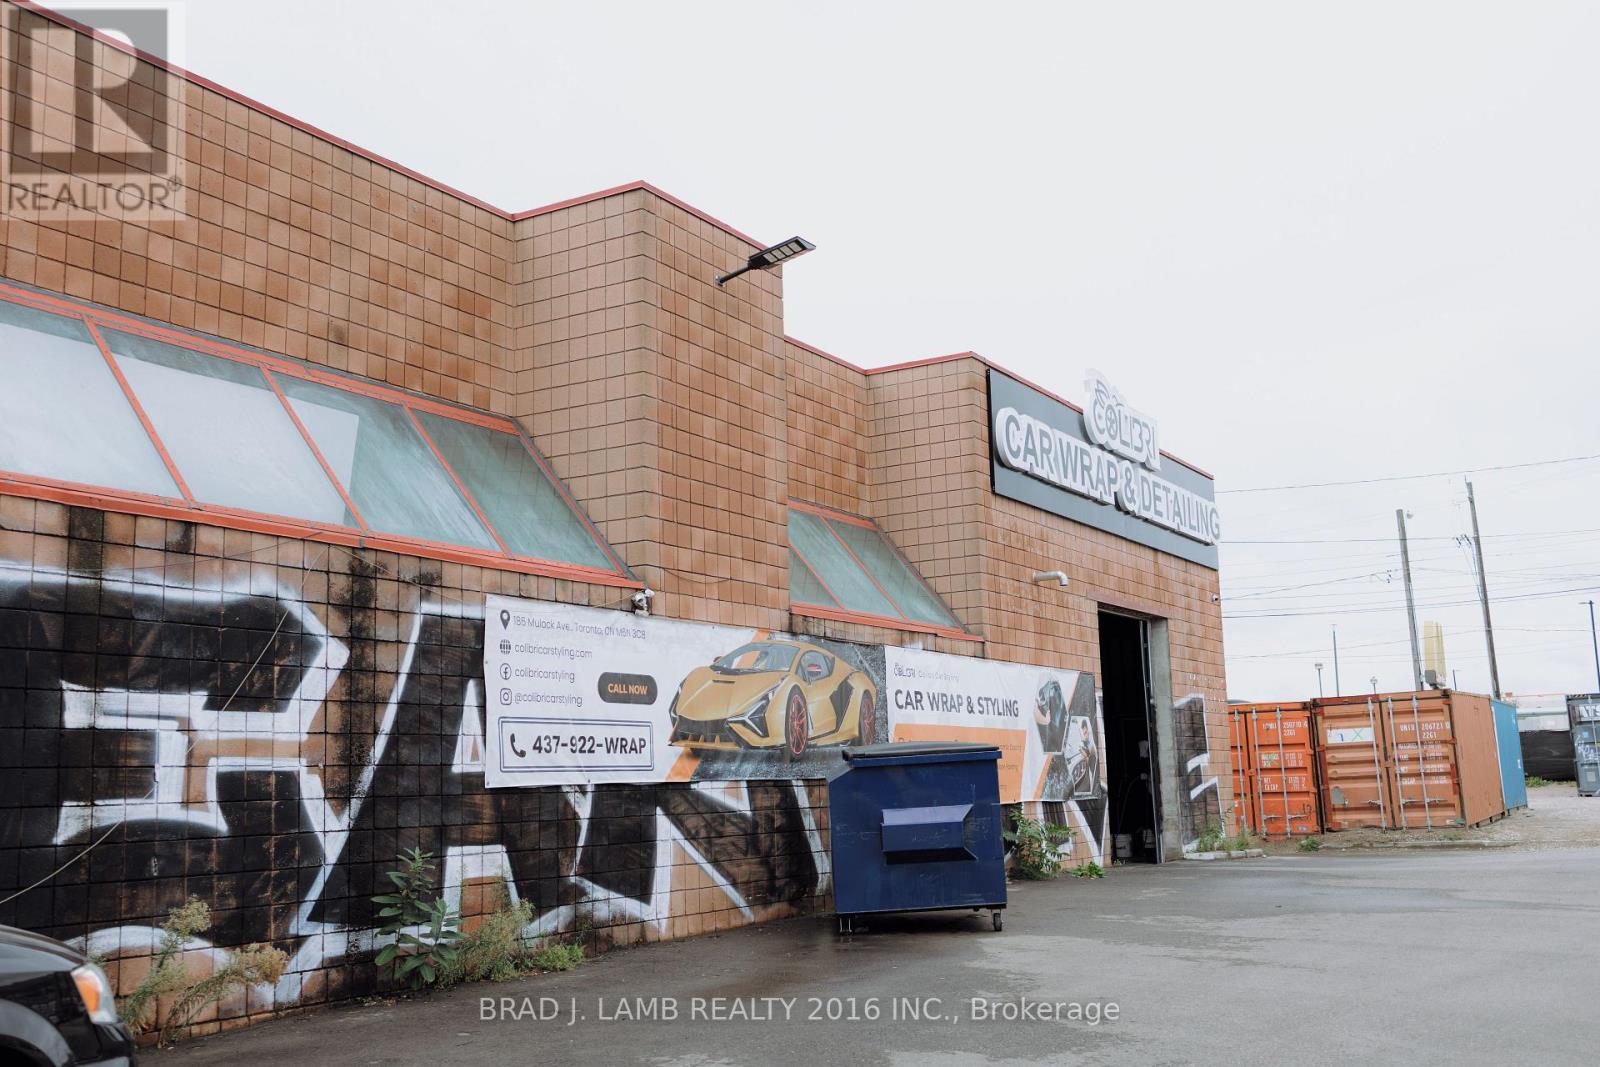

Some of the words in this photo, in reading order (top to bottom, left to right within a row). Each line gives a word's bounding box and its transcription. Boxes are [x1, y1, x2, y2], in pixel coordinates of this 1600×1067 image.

[1123, 466, 1137, 505] &
[1140, 474, 1221, 541] DETAILING
[527, 618, 555, 629] Mulock
[604, 626, 615, 636] ON
[514, 643, 593, 660] colibricarstyling.com
[514, 667, 575, 683] colibricarstyling
[607, 683, 627, 695] CALL
[628, 685, 648, 696] NOW
[514, 692, 583, 708] @colibricarstyling
[894, 688, 924, 711] CAR
[927, 691, 964, 714] WRAP
[966, 695, 975, 715] &
[977, 696, 1019, 718] STYLING
[532, 735, 647, 755] 437-922-WRAP
